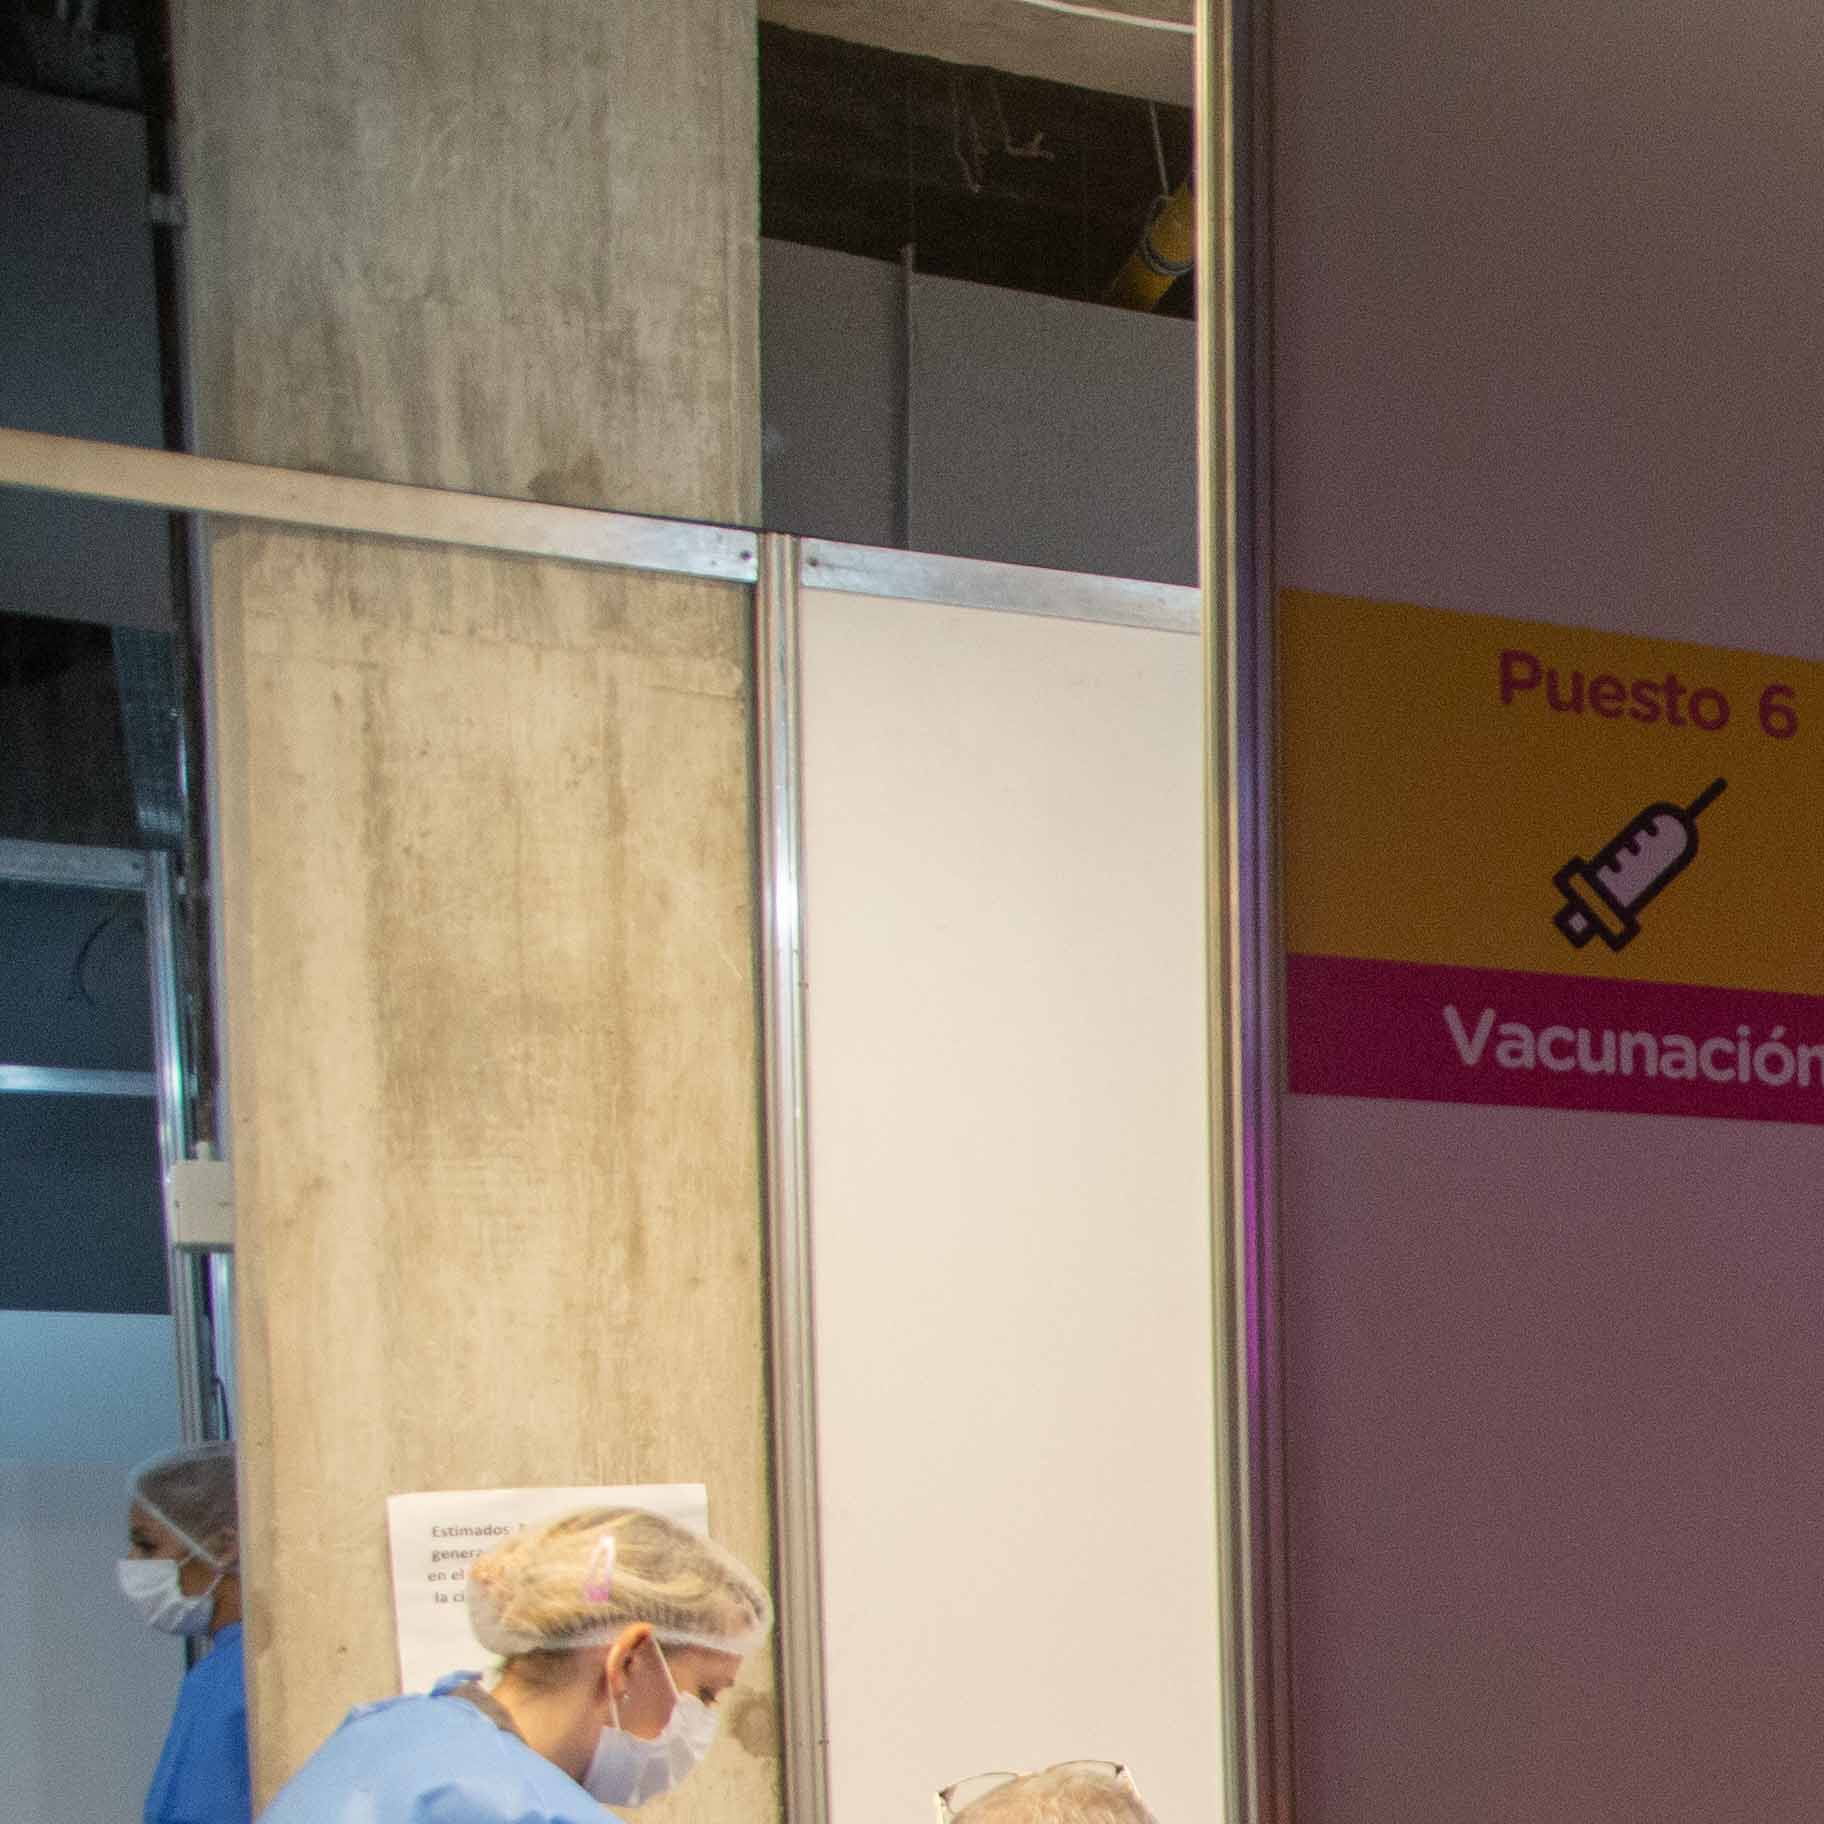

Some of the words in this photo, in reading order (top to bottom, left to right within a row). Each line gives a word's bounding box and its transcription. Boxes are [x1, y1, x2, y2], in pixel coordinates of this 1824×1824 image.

[1499, 650, 1731, 731] Puesto
[1757, 682, 1800, 740] 6
[431, 1524, 511, 1538] Estimados
